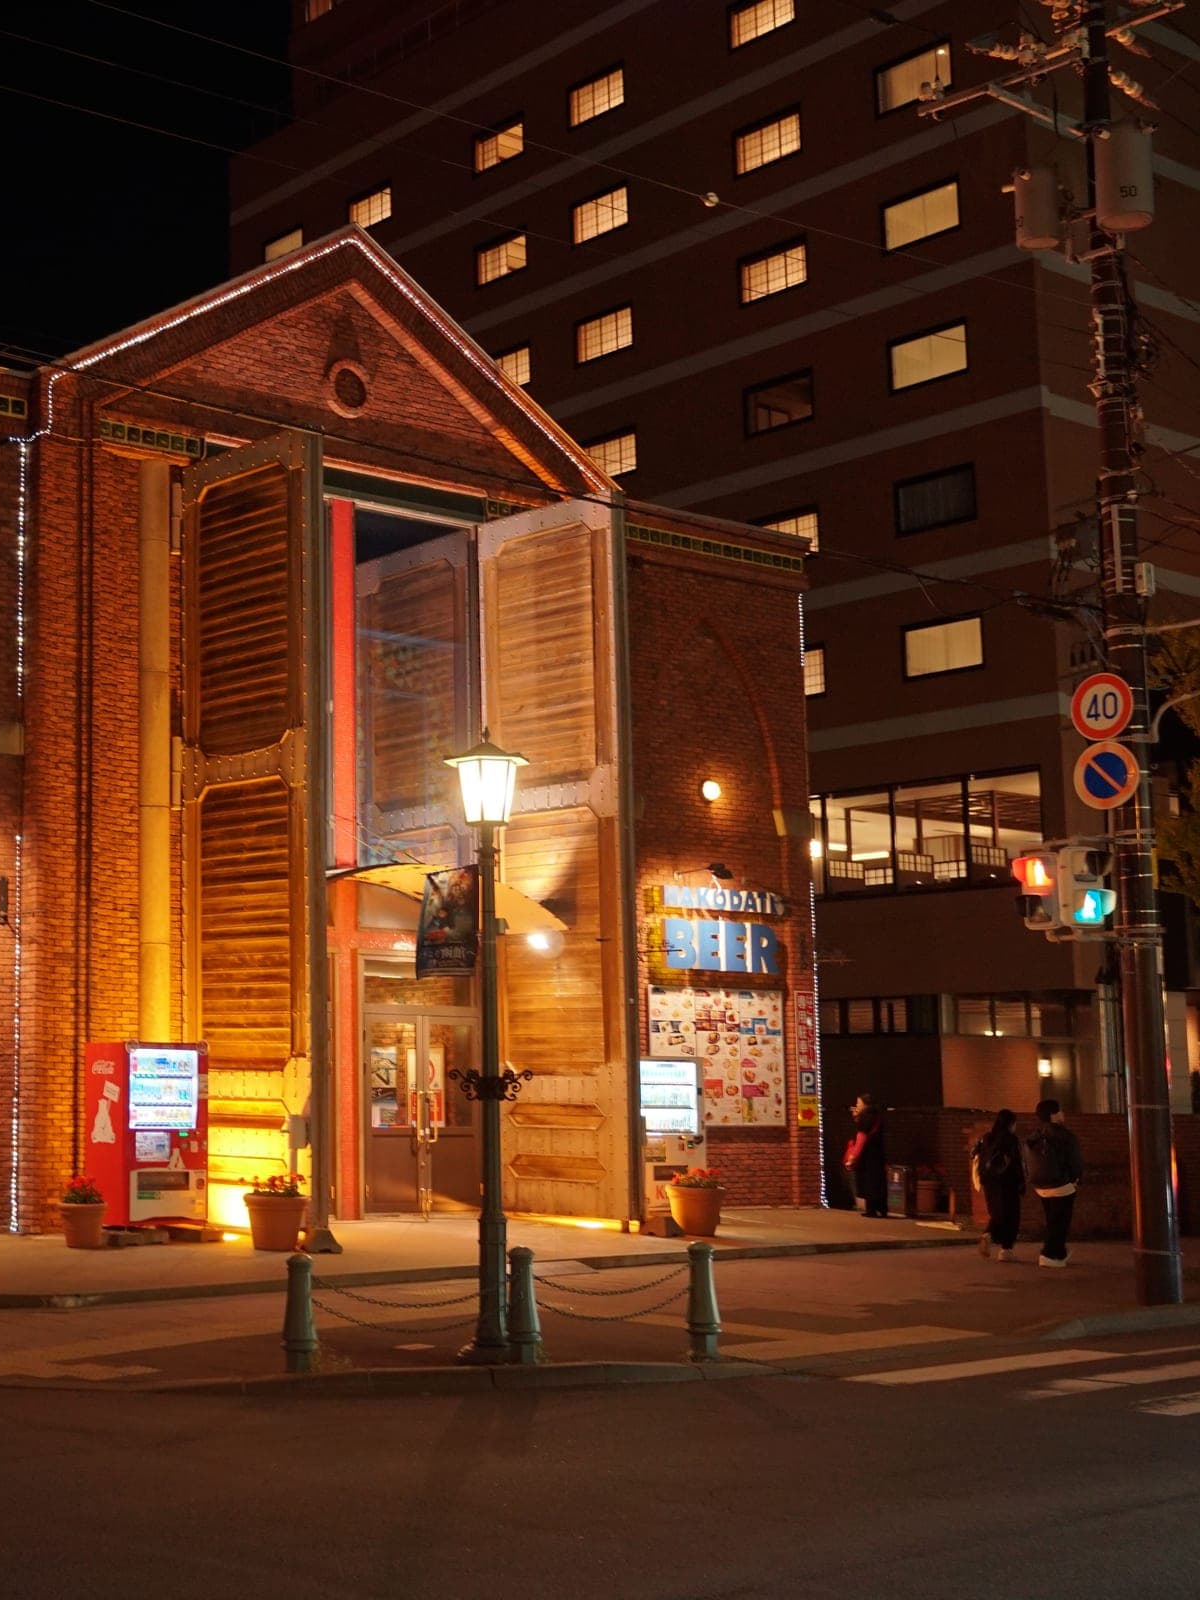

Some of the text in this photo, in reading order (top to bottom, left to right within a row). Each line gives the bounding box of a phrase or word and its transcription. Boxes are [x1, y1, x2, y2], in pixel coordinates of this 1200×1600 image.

[1120, 185, 1137, 198] 50
[1087, 692, 1117, 721] 40
[664, 918, 779, 974] BEER
[801, 1072, 815, 1094] P
